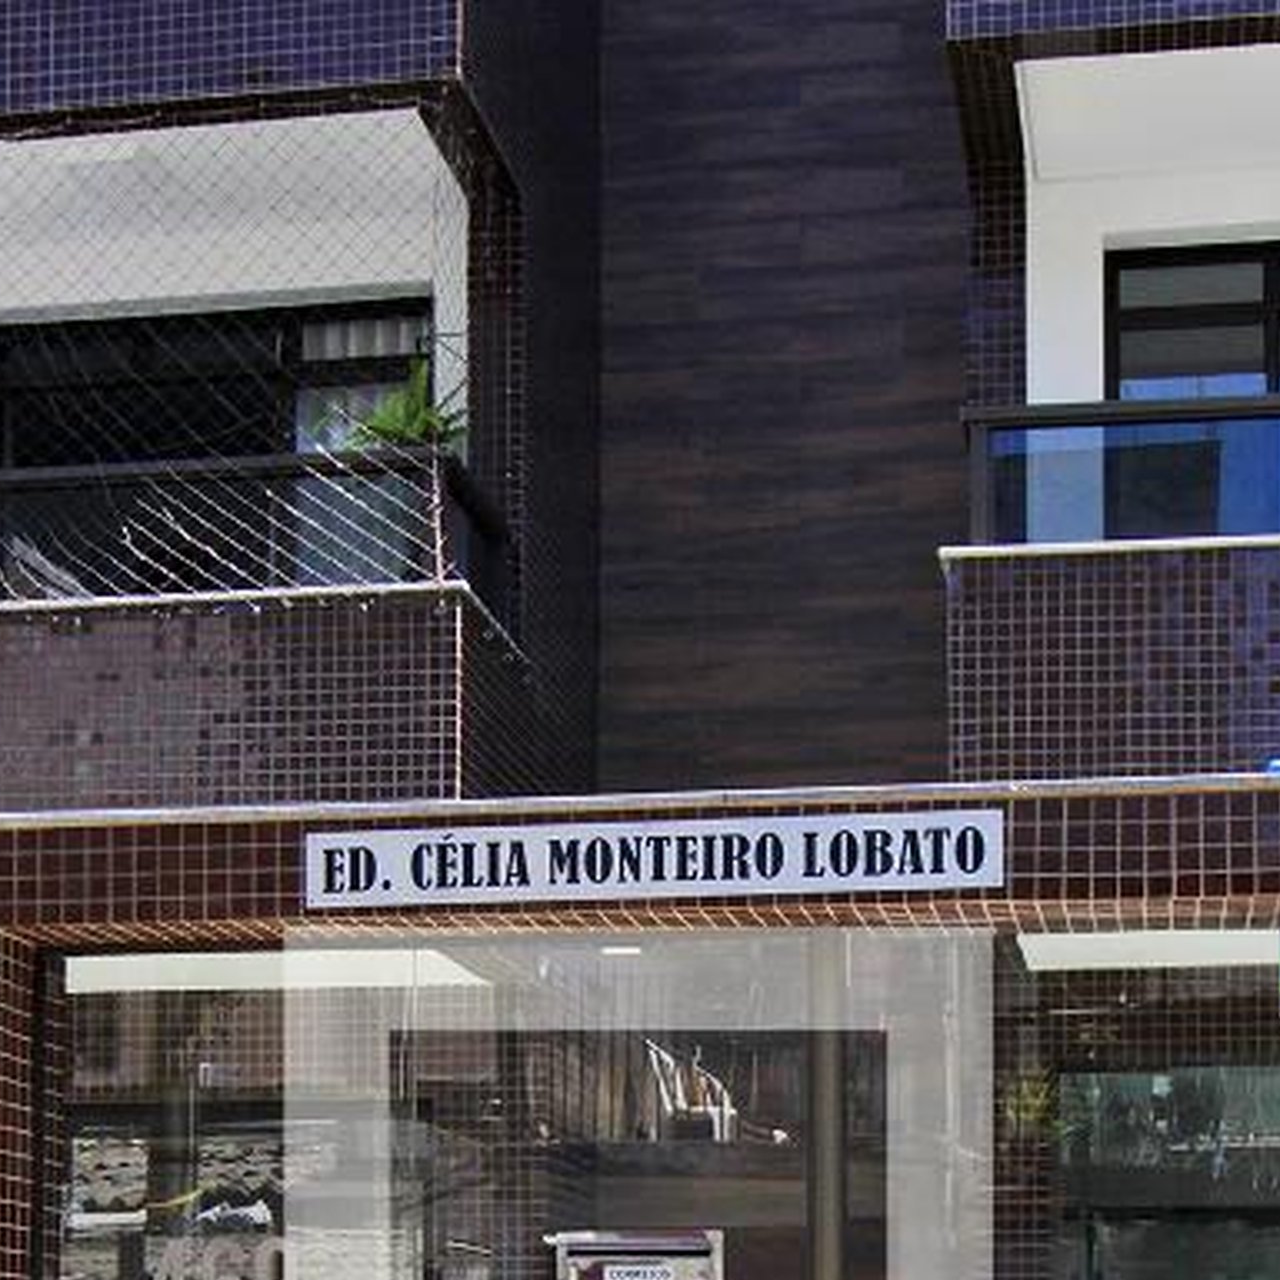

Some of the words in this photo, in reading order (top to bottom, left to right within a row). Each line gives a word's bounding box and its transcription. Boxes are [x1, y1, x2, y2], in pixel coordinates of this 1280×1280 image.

[322, 846, 392, 894] ED.
[410, 833, 531, 891] CÉLIA
[548, 831, 785, 885] MONTEIRO
[802, 825, 986, 878] LOBATO
